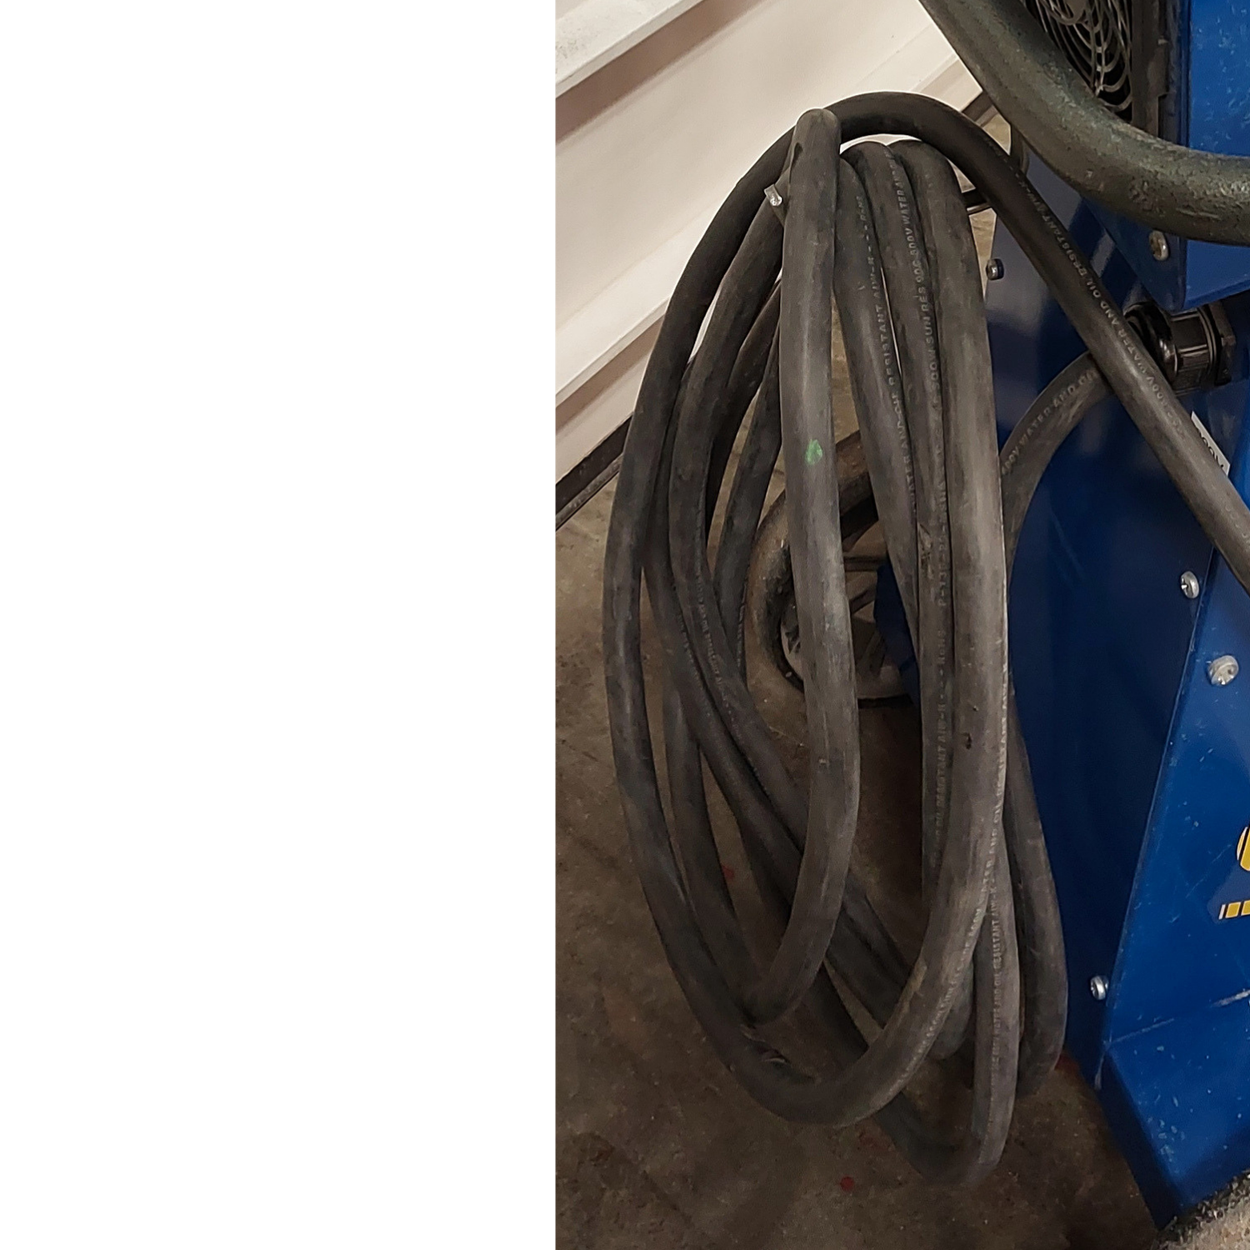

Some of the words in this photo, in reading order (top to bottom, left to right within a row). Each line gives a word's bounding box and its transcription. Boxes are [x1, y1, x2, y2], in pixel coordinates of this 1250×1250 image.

[895, 187, 912, 225] WATER
[917, 284, 929, 312] RES
[1084, 277, 1103, 300] OIL
[921, 315, 935, 345] SUN
[1098, 299, 1121, 327] AND
[874, 303, 896, 387] RESISTANT
[1115, 327, 1149, 374] WATER
[1017, 404, 1053, 447] WATER
[1050, 382, 1078, 408] AND
